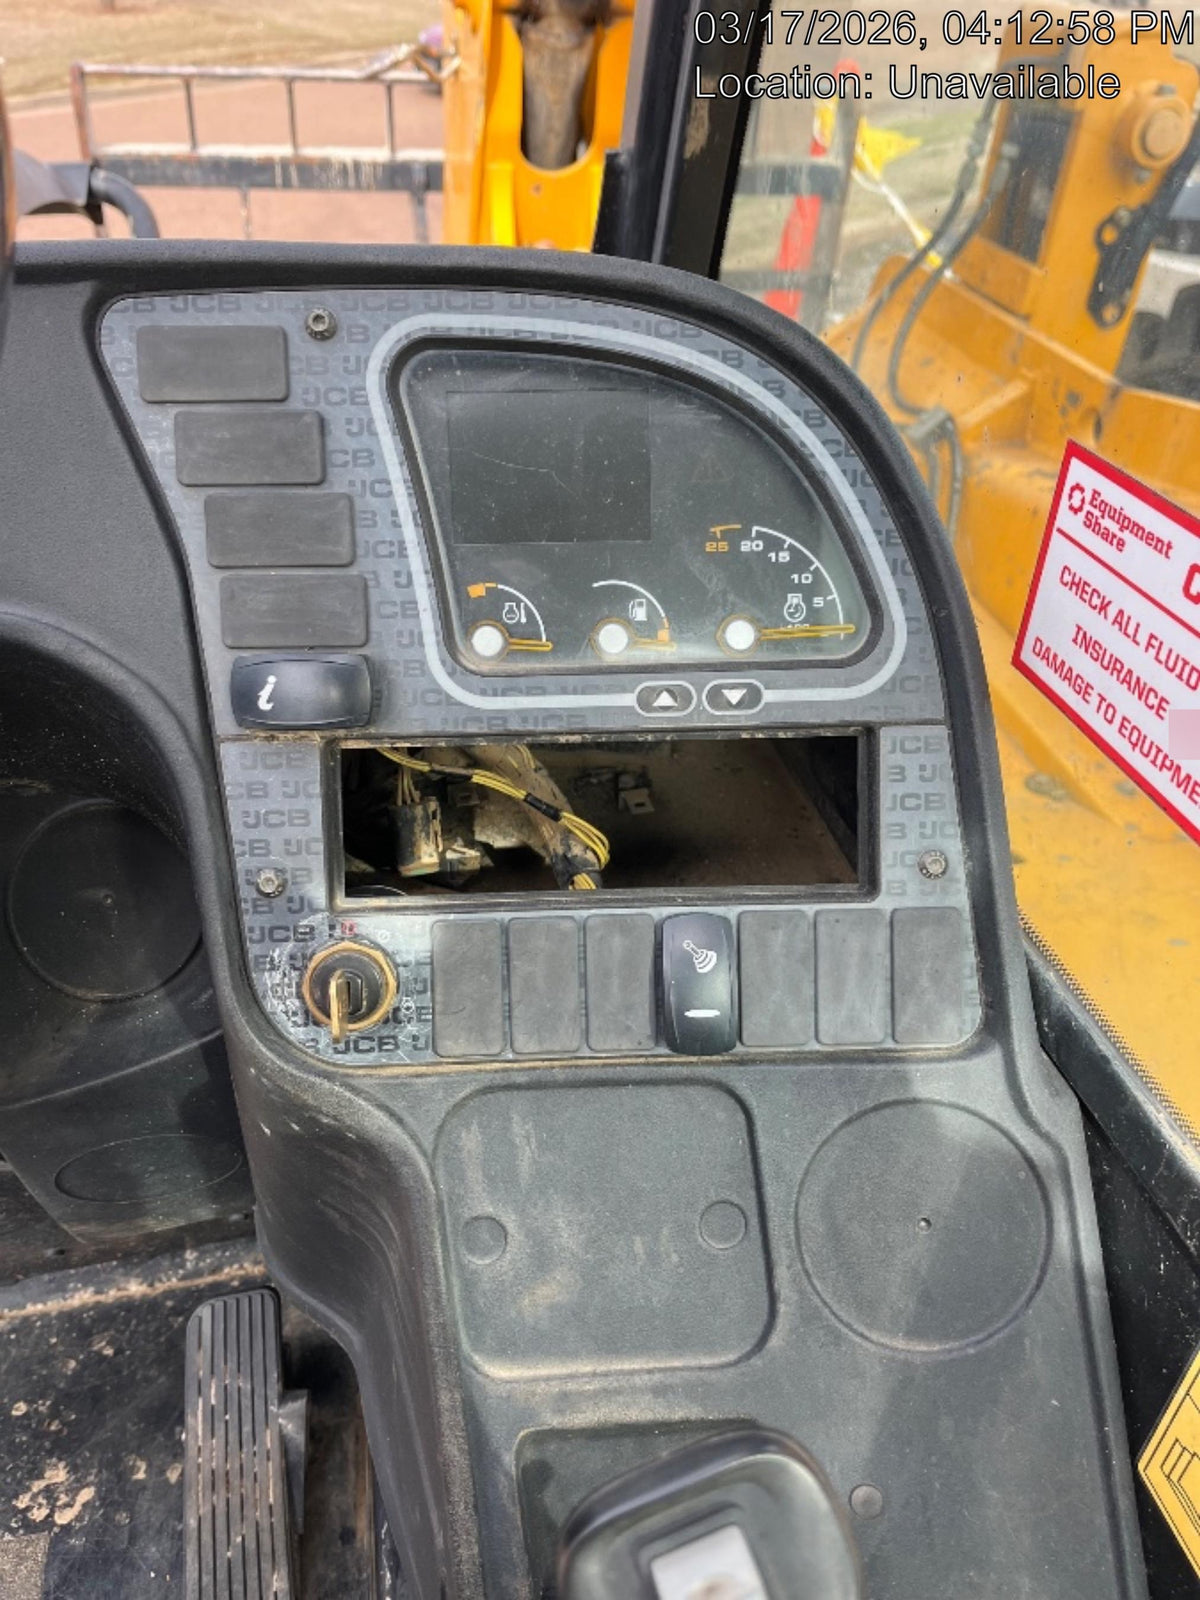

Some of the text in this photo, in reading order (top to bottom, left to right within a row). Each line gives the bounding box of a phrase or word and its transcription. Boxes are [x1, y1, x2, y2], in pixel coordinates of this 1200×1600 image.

[1083, 510, 1126, 552] Share
[1088, 488, 1173, 560] Equipment
[705, 540, 764, 552] 25 20
[768, 551, 790, 563] 15
[791, 573, 813, 585] 10
[812, 597, 824, 607] 5
[1059, 565, 1112, 620] CHECK
[1111, 608, 1141, 647] ALL
[1072, 624, 1170, 721] INSURANCE
[1032, 636, 1200, 808] DAMAGE TO EQUIPME
[241, 809, 311, 829] JCB
